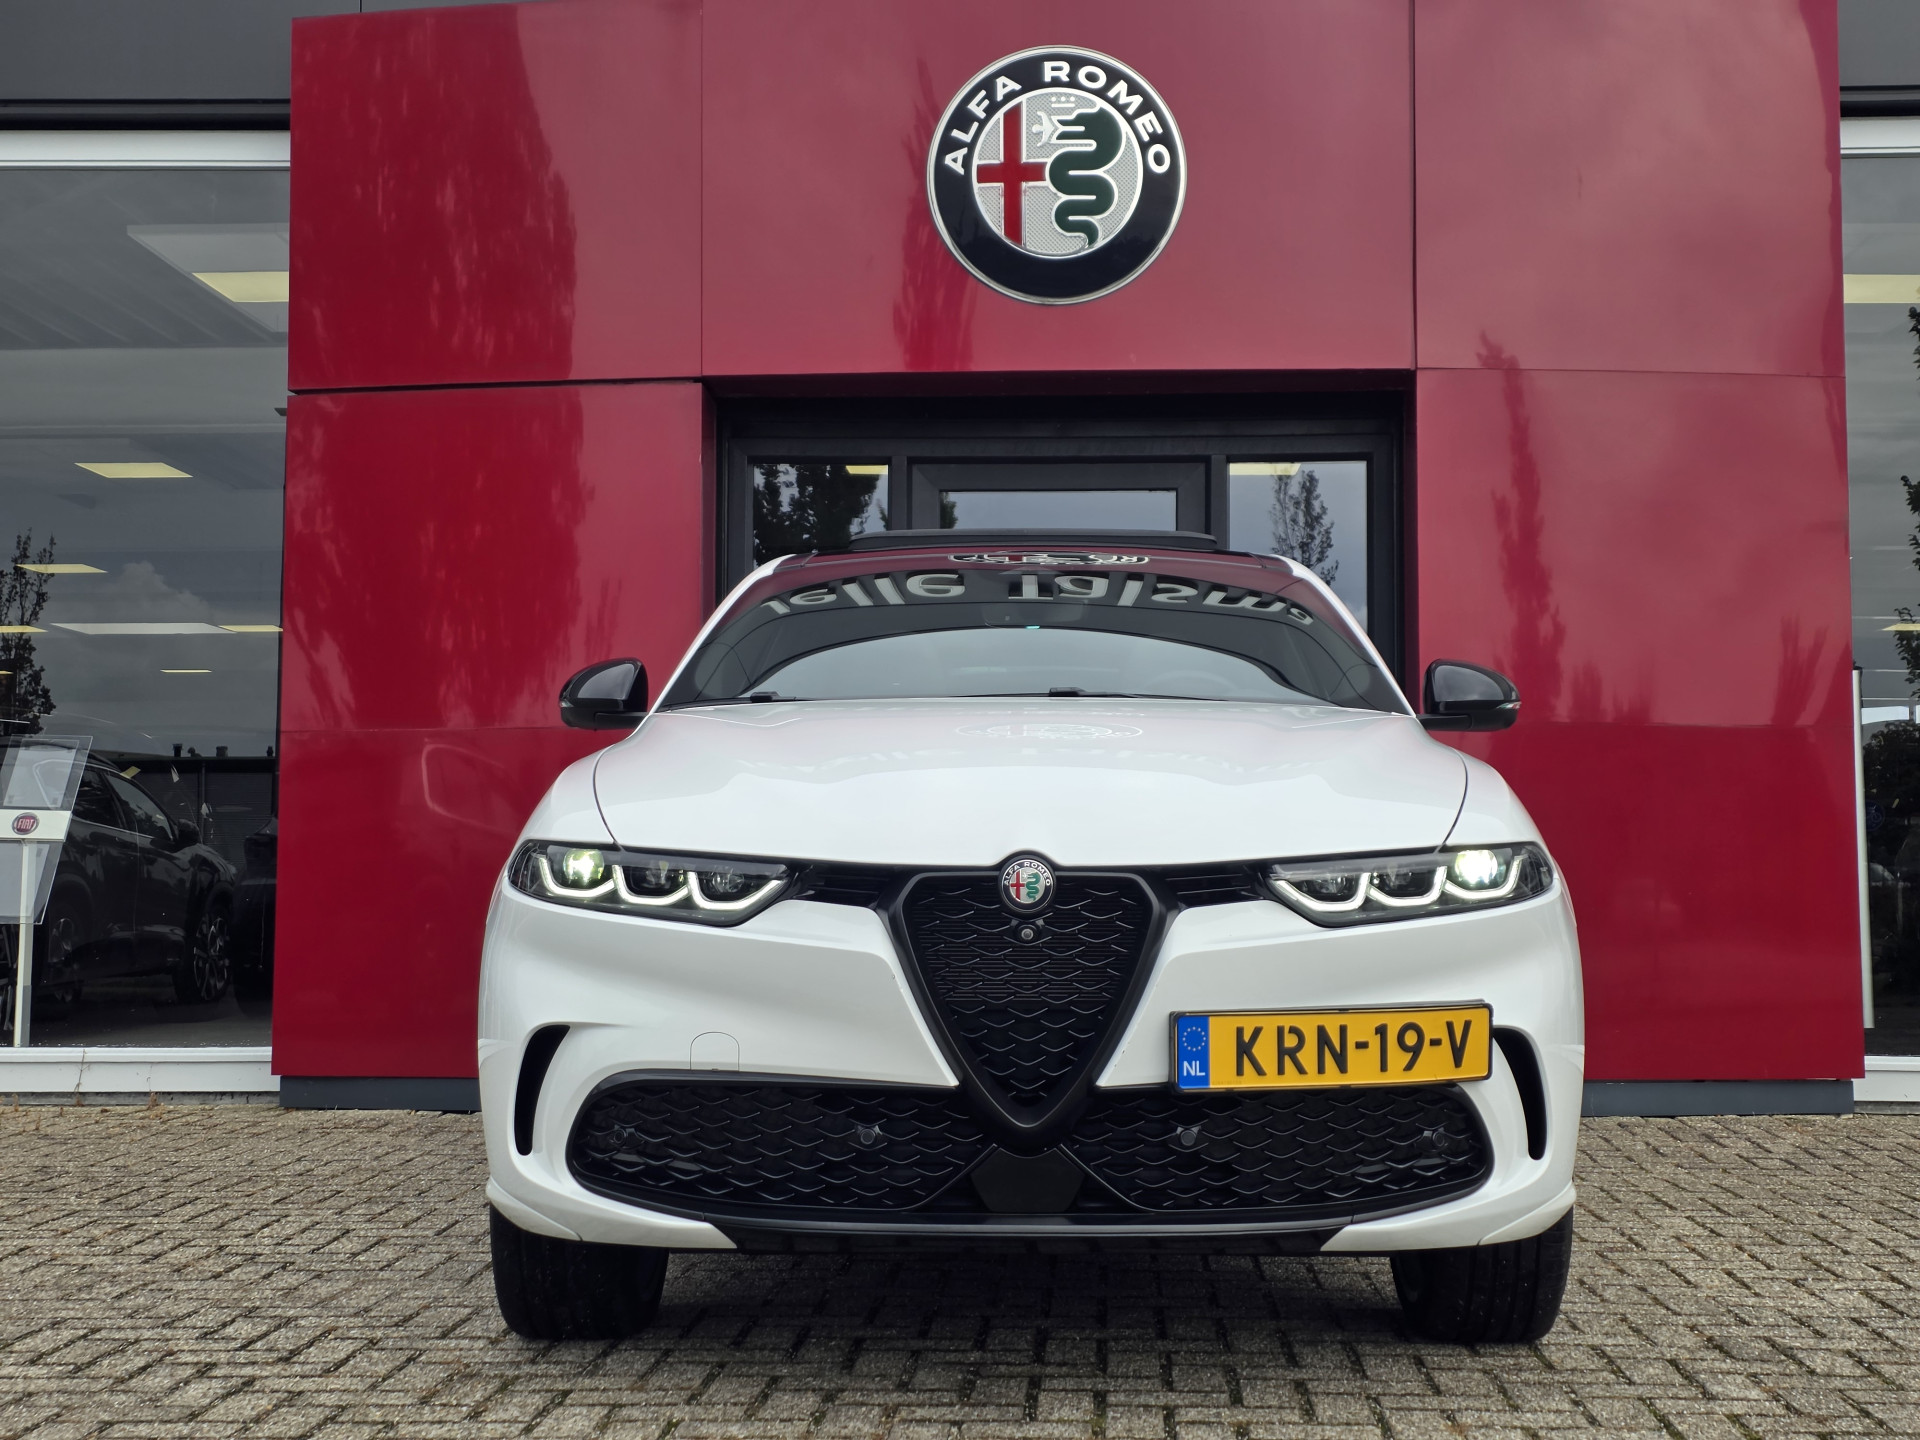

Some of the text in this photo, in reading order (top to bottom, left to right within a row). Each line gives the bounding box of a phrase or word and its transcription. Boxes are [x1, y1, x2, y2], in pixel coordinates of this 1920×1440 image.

[944, 61, 1171, 175] ALFA ROMEO
[17, 818, 35, 830] FIAT
[1004, 861, 1051, 887] ALFA ROMEO
[1236, 1019, 1472, 1077] KRN-19-V
[1183, 1060, 1206, 1077] NL
